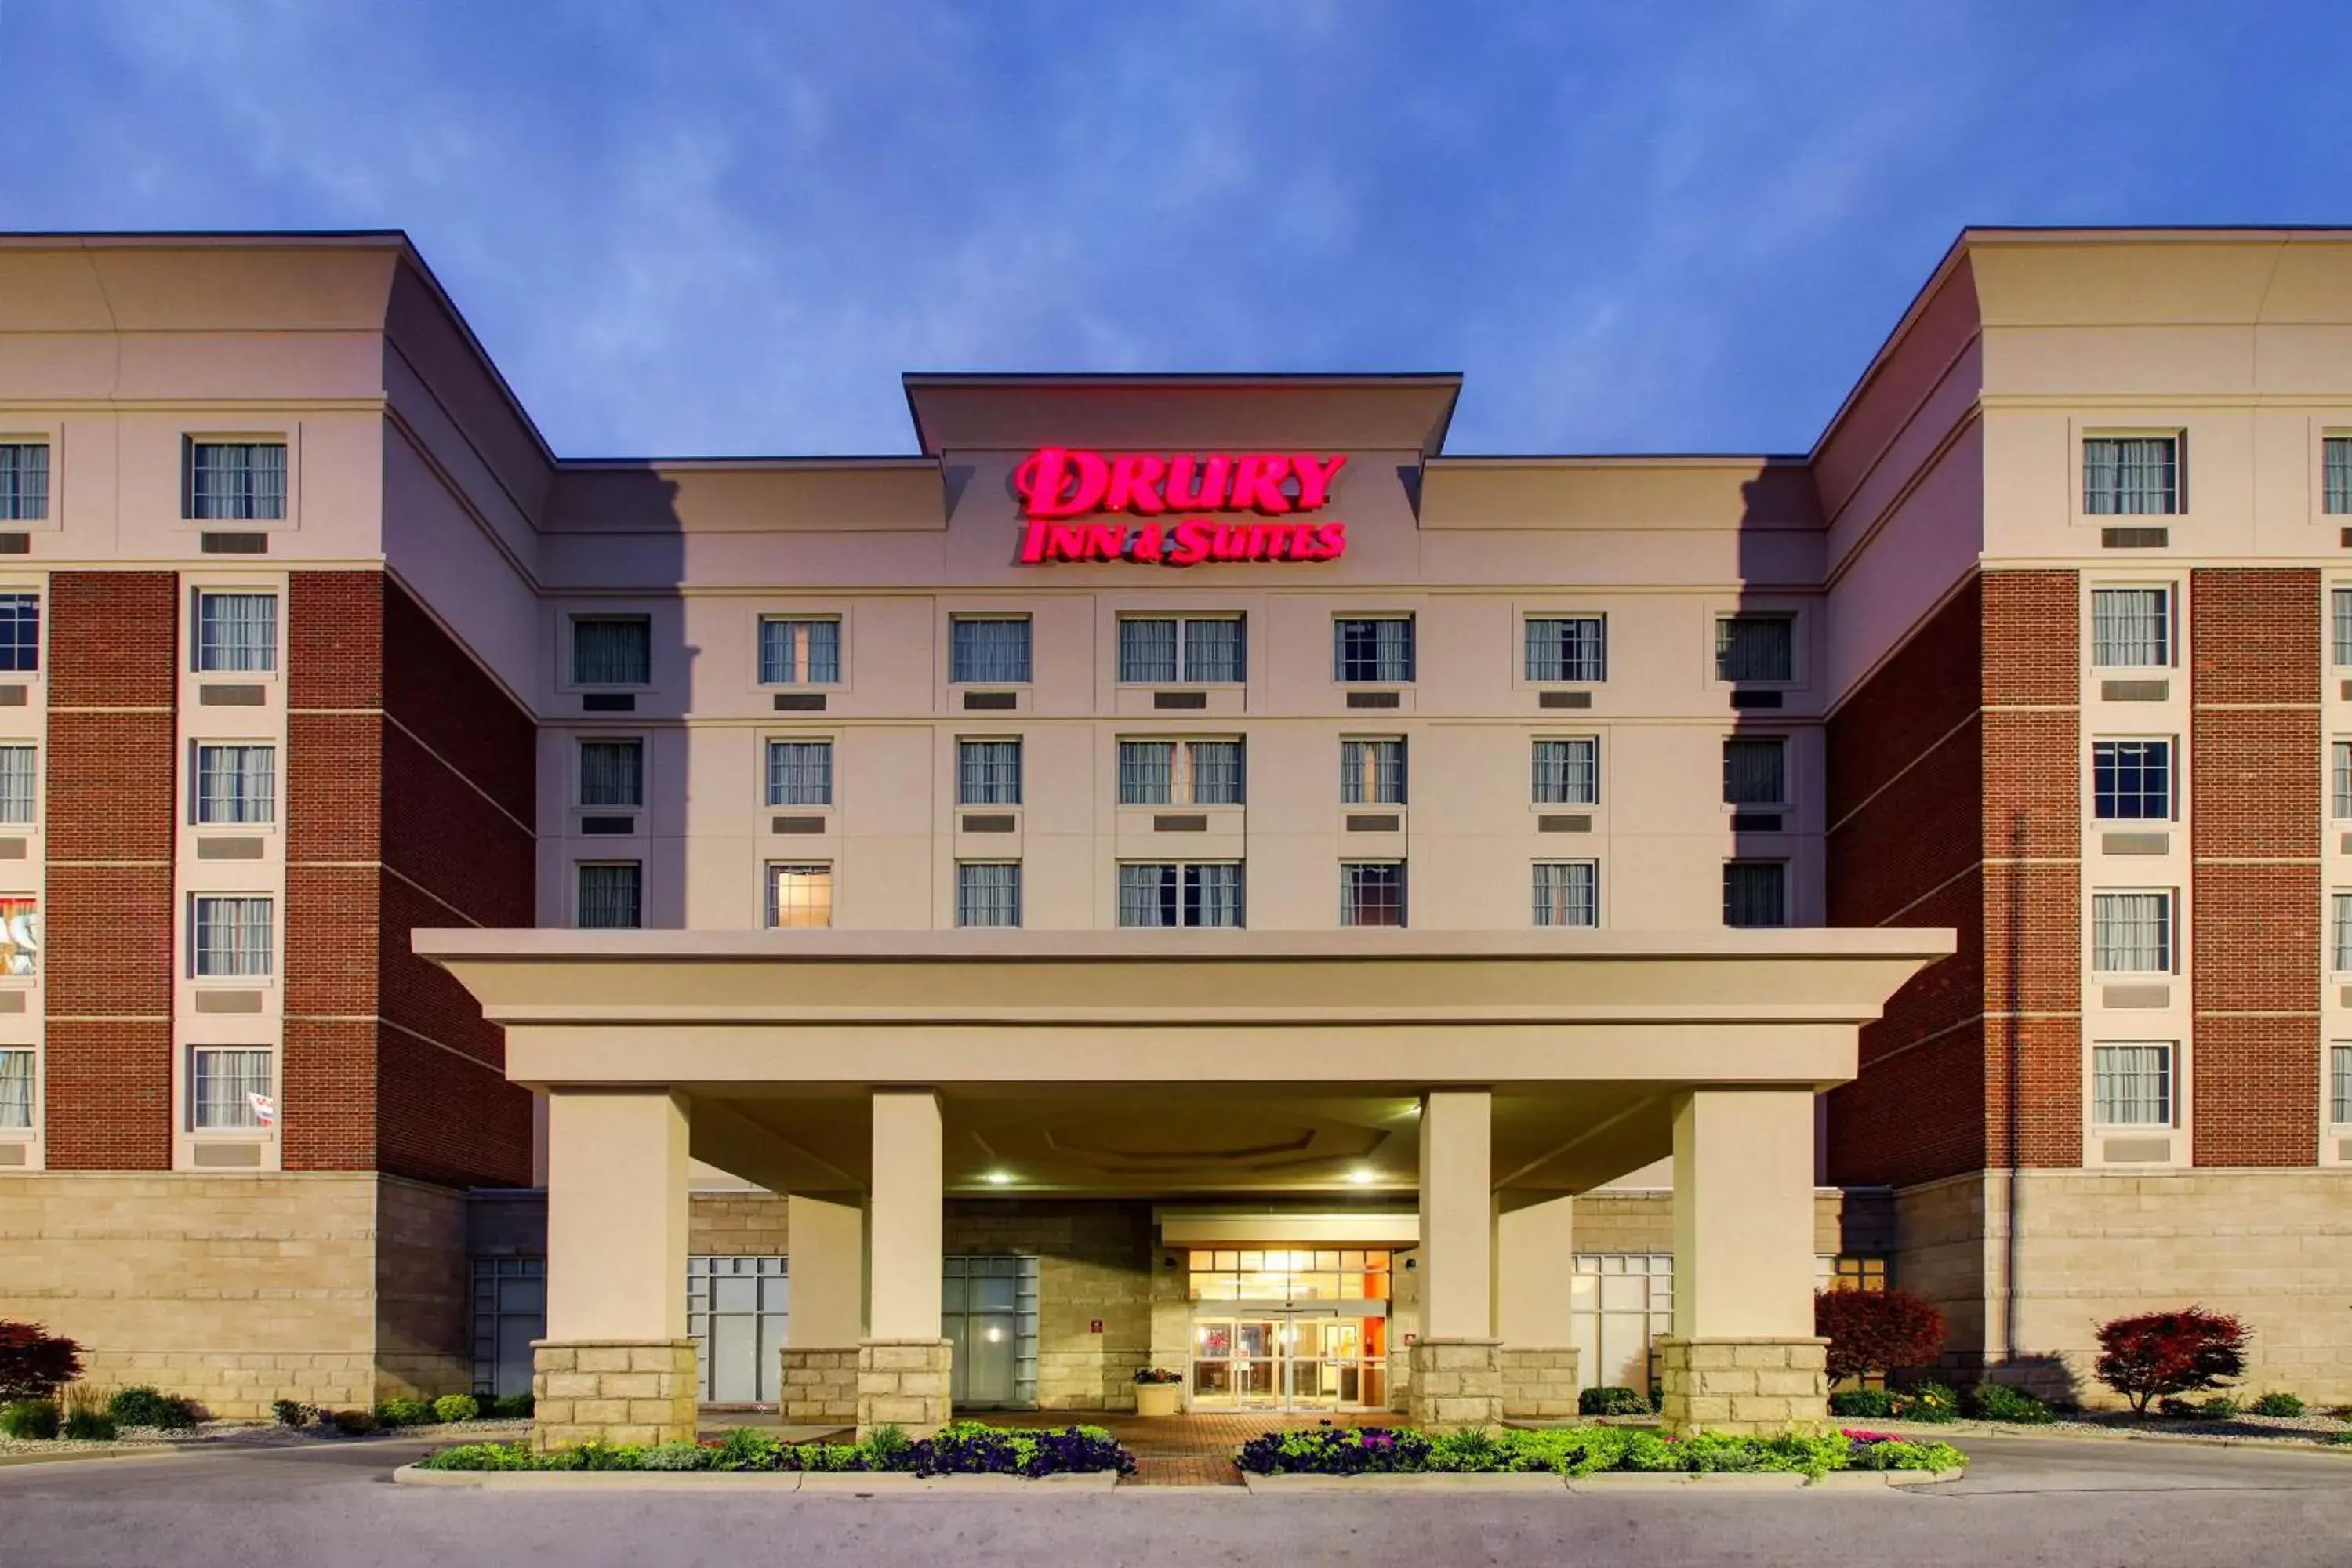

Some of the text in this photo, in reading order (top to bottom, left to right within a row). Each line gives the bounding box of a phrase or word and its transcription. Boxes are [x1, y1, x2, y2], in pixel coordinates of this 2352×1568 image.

[1015, 446, 1347, 518] DRURY
[1021, 515, 1346, 564] INN & SUITES
